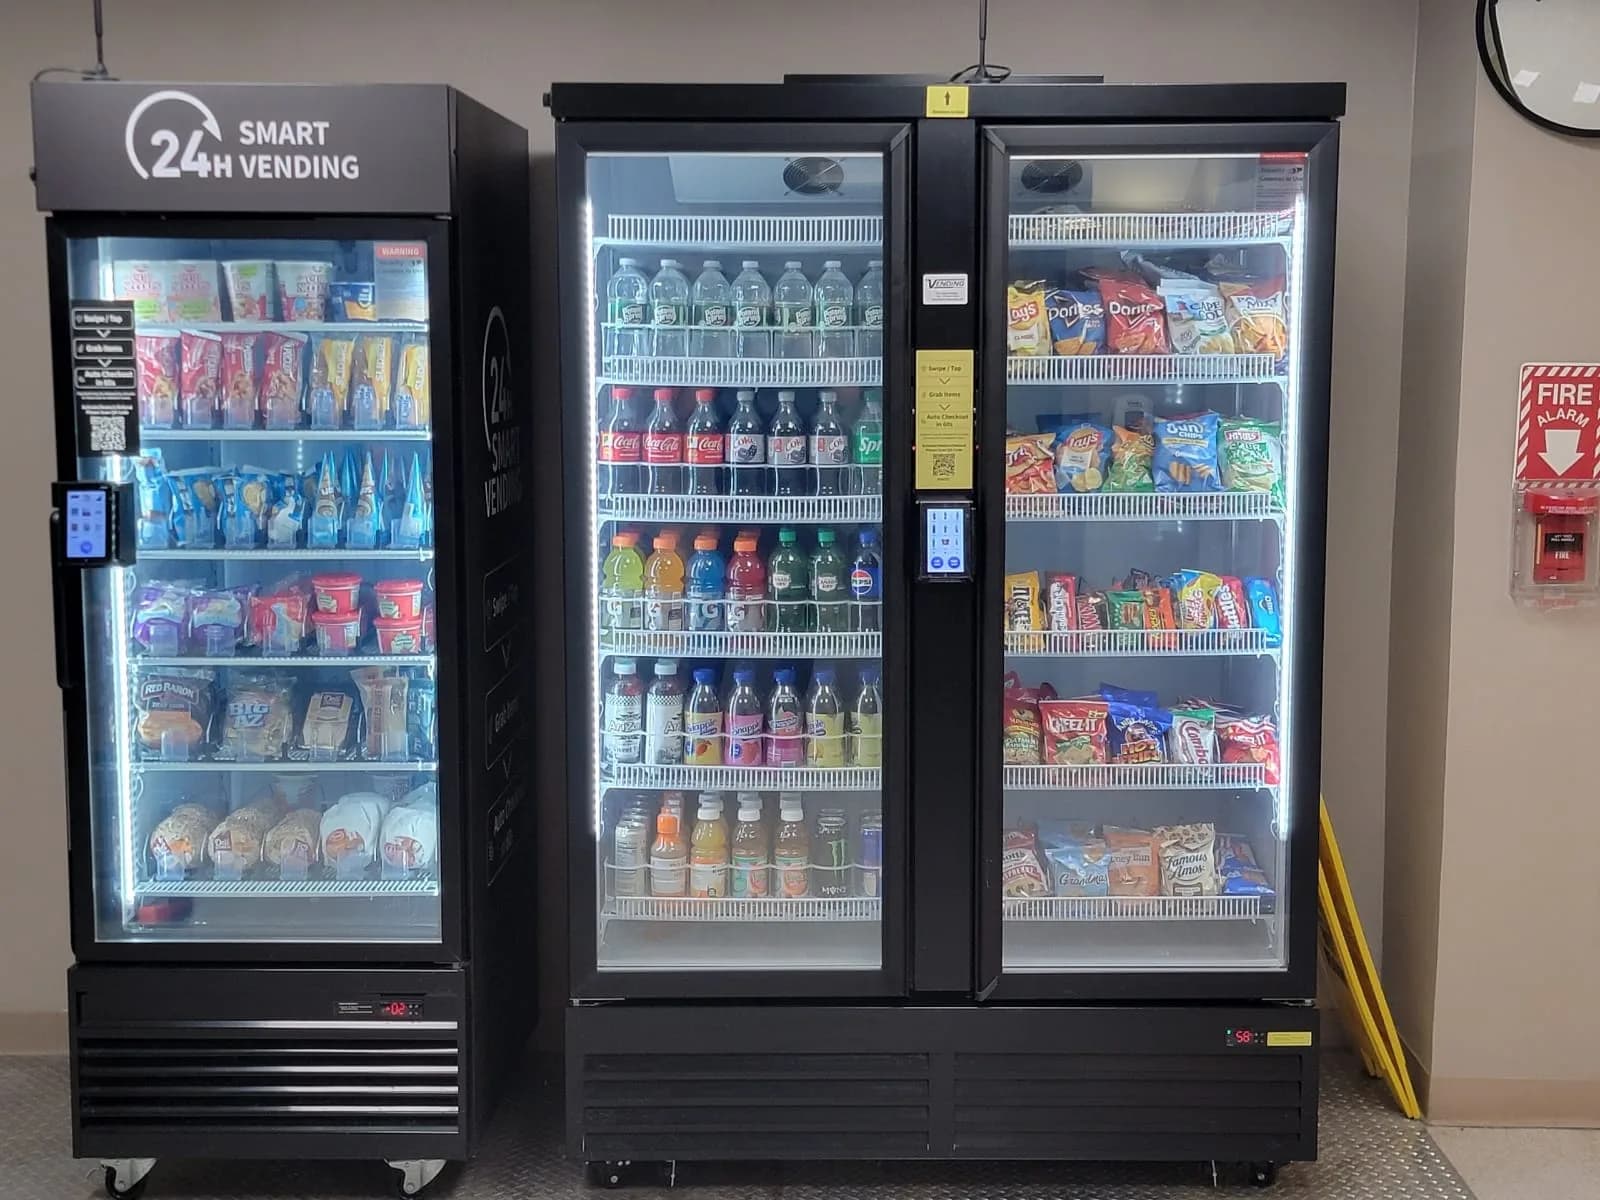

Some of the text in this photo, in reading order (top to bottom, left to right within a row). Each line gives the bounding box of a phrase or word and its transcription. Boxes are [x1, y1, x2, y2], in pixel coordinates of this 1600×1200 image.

[239, 120, 330, 146] SMART
[150, 129, 232, 179] 24H
[239, 154, 360, 180] VENDING
[382, 248, 420, 256] WARNING
[1537, 383, 1593, 405] FIRE
[1537, 407, 1590, 428] ALARM
[1555, 551, 1569, 559] FIRE
[145, 682, 194, 699] RED BARON
[228, 703, 270, 714] BIG
[1167, 853, 1208, 871] Famous
[1168, 863, 1206, 880] Amos
